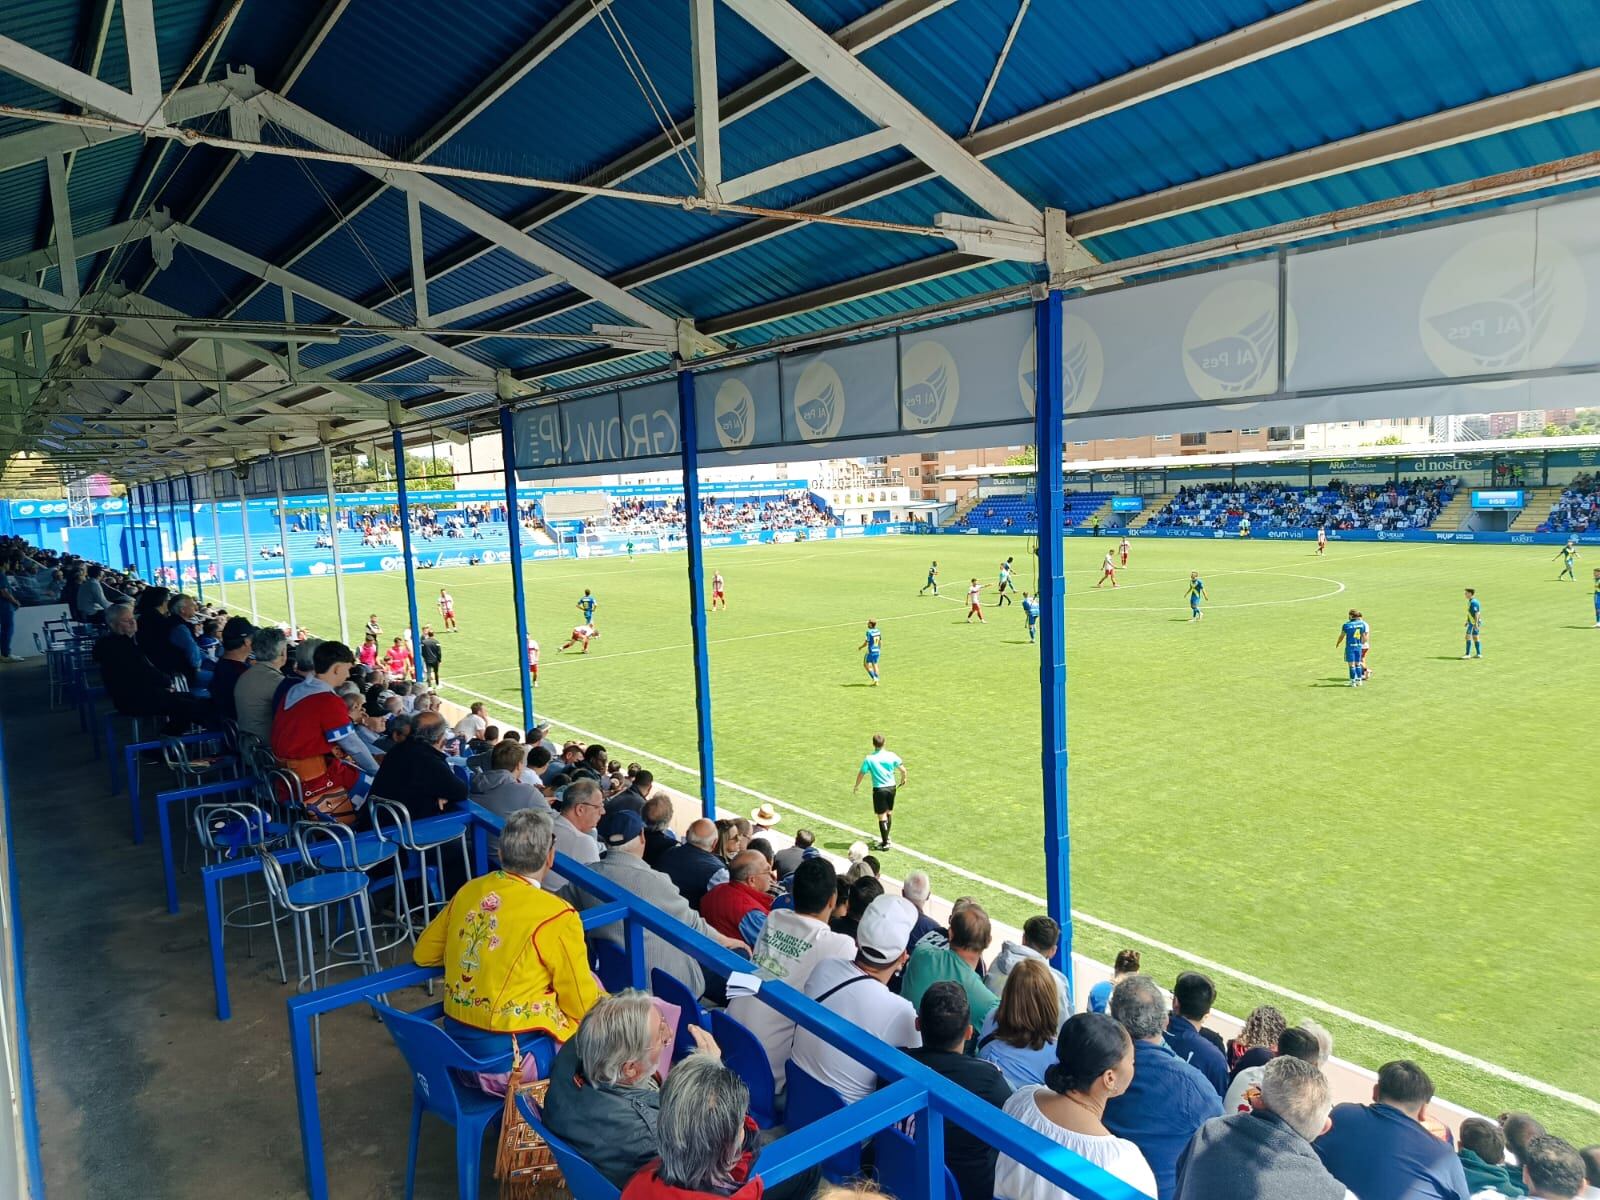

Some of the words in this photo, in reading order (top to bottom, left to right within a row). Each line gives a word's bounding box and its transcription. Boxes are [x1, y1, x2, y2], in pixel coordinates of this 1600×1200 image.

[1414, 460, 1427, 471] el
[1429, 457, 1472, 471] nostre
[1289, 530, 1304, 538] vial
